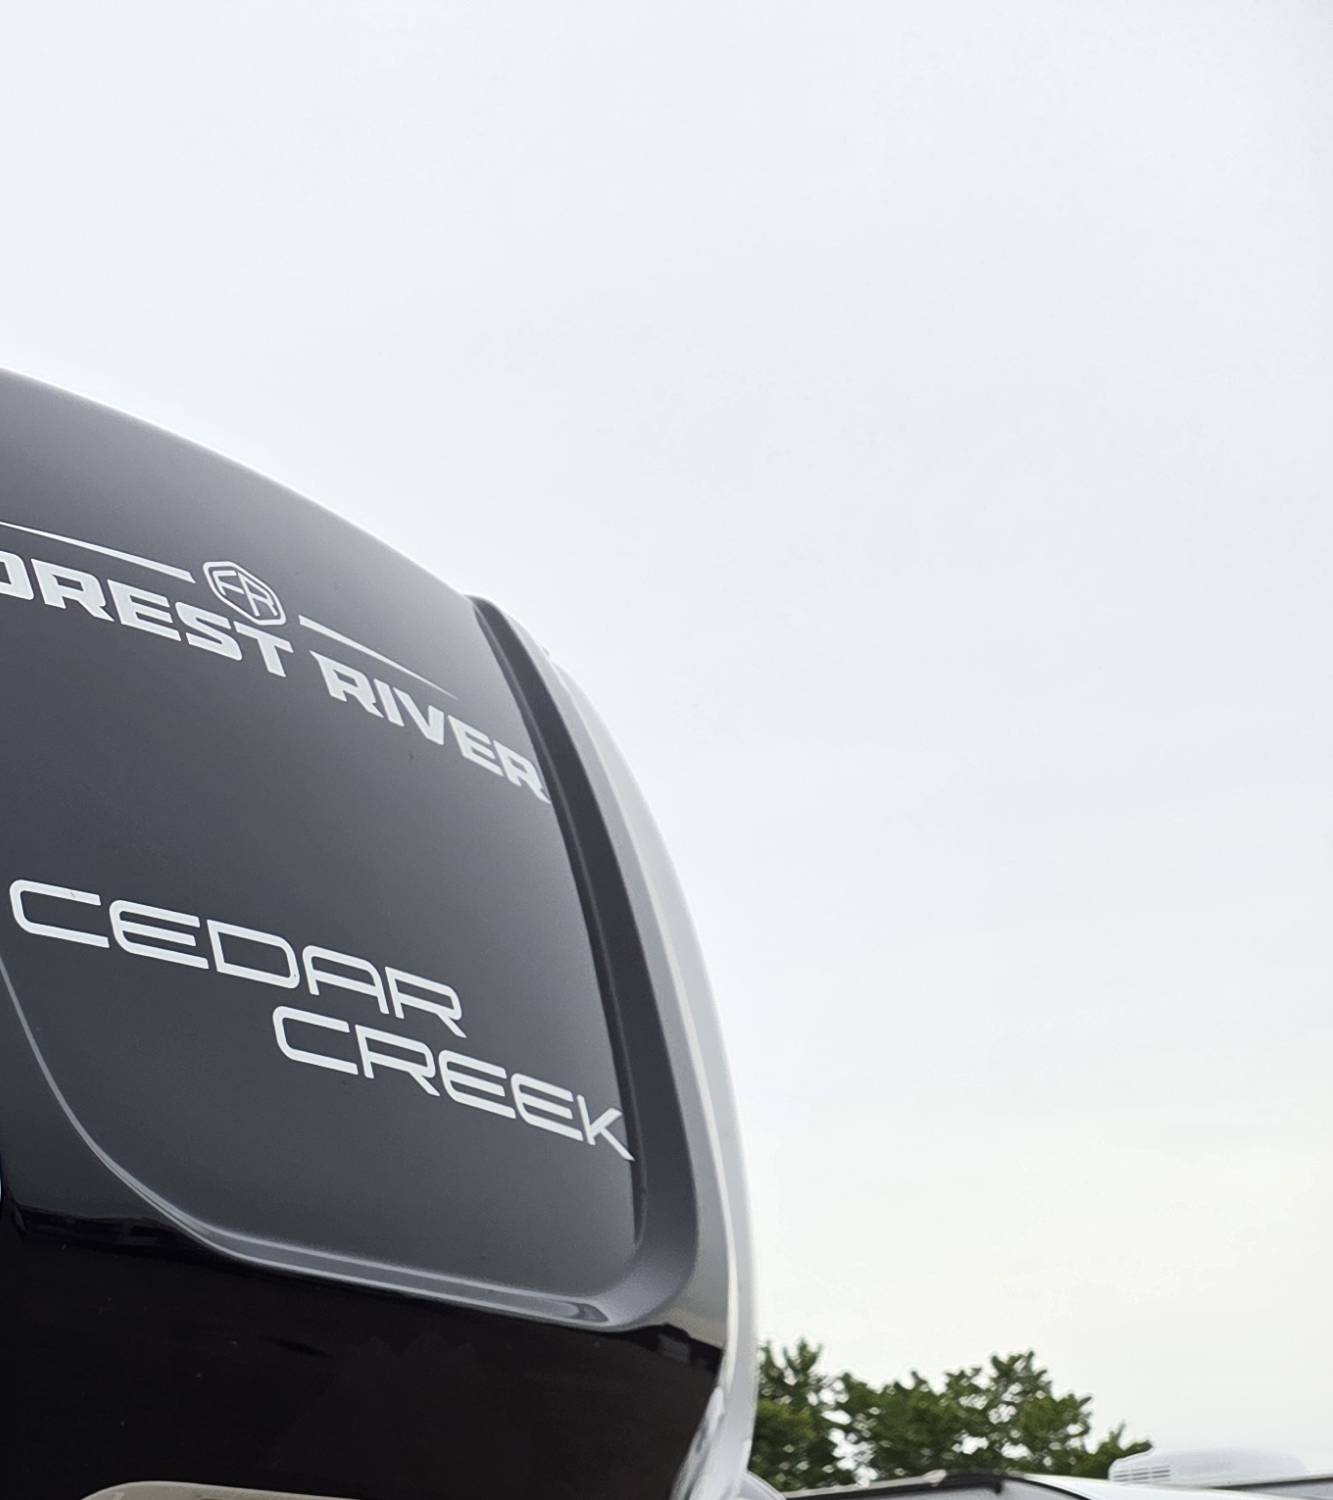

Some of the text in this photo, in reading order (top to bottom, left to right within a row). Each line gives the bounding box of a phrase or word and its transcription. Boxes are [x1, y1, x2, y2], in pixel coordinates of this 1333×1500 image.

[309, 650, 550, 803] RIVER
[9, 879, 465, 1038] CEDAR
[272, 1005, 634, 1161] CREEK
